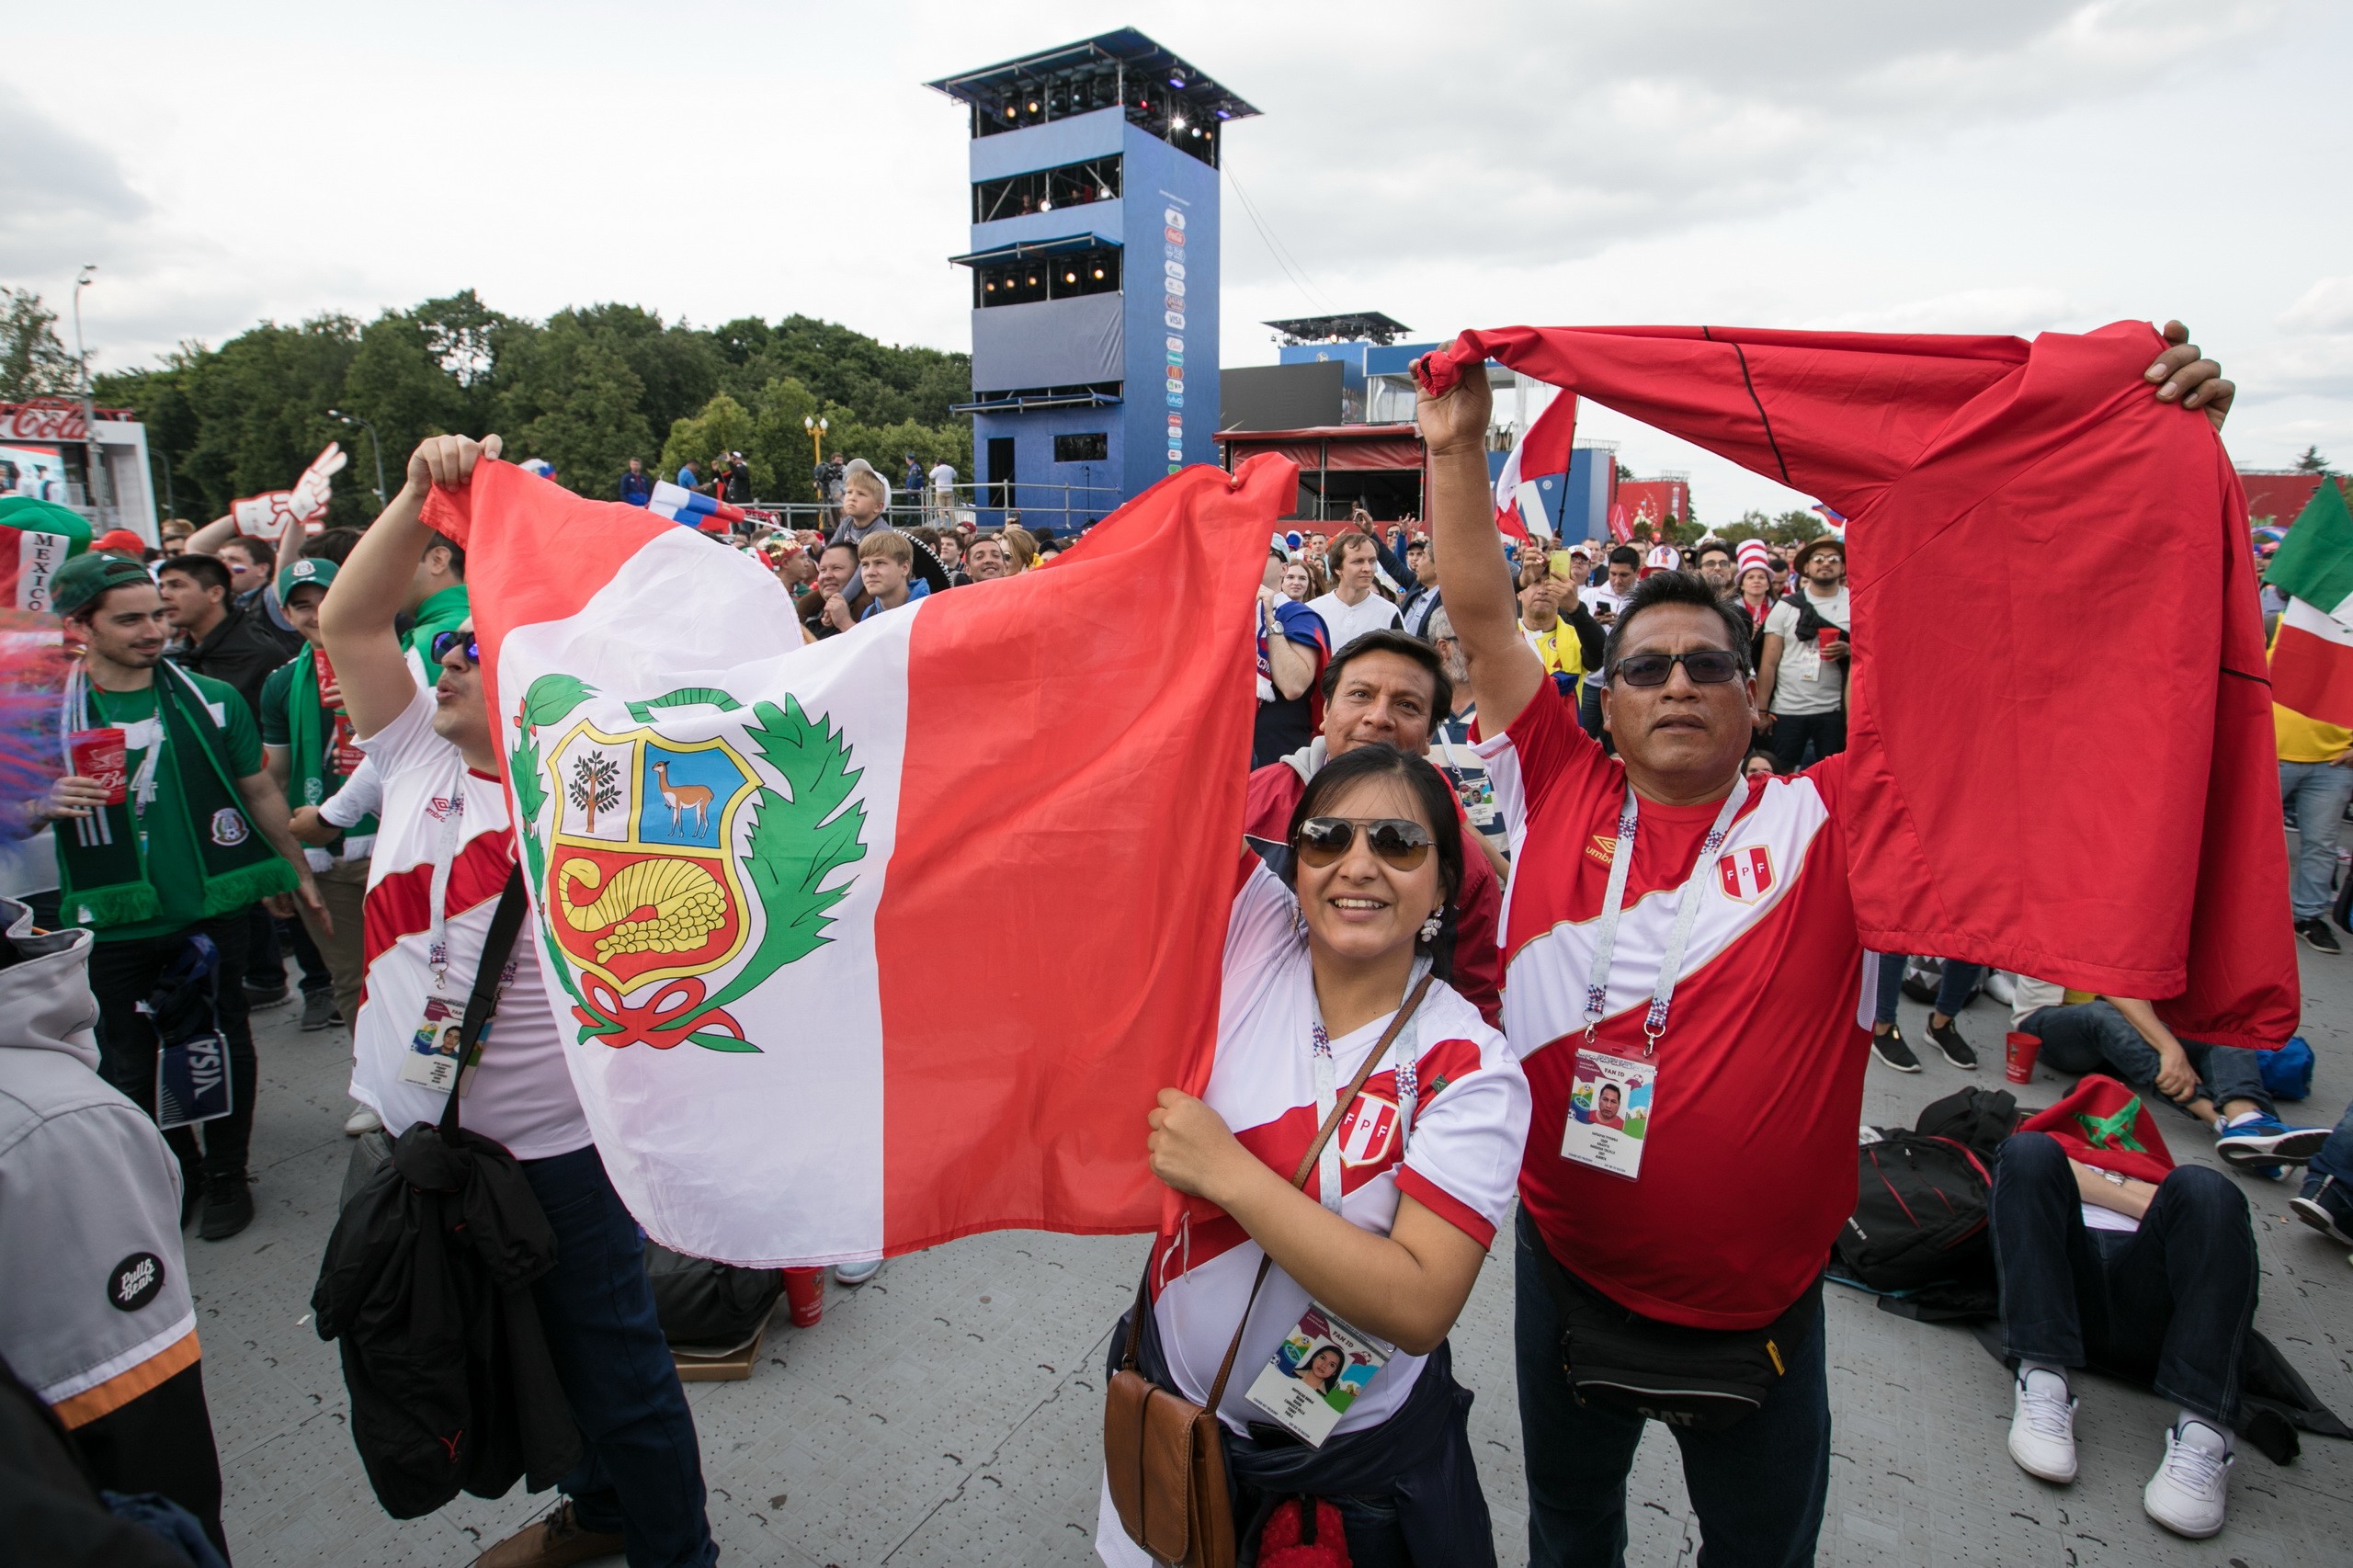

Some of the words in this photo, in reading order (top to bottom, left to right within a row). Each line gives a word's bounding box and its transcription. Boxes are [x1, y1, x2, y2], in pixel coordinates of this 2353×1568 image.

[28, 533, 55, 611] MEXICO
[1586, 846, 1613, 864] umbr
[187, 1039, 222, 1100] VISA
[1604, 1067, 1617, 1075] FAN
[118, 1275, 154, 1301] Bear
[1332, 1331, 1346, 1343] FAN
[1346, 1340, 1354, 1348] ID
